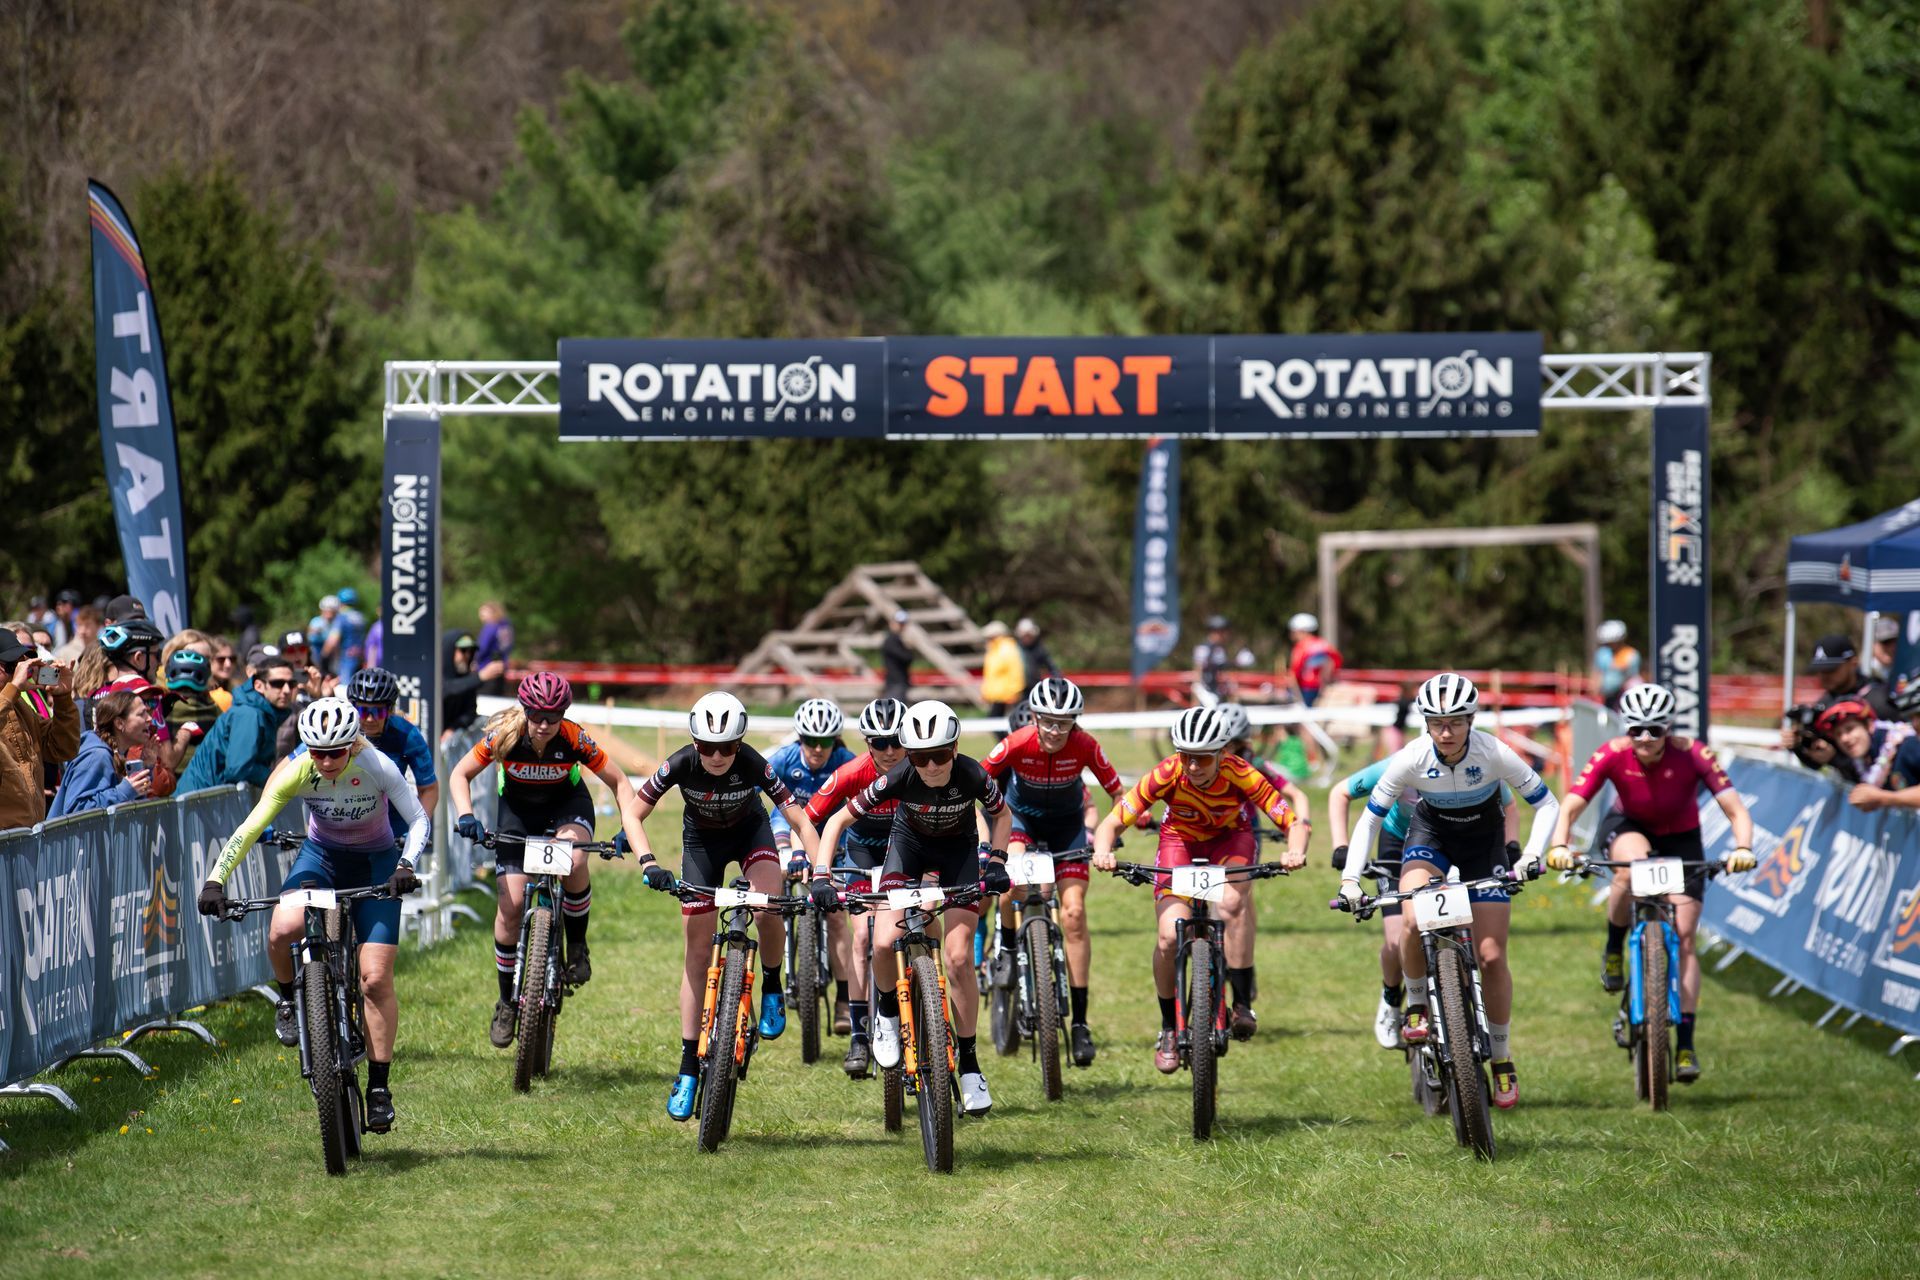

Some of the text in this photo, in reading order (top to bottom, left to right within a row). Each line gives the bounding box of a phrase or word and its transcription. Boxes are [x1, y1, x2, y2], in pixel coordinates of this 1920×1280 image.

[588, 356, 856, 421] ROTATION
[925, 355, 1172, 417] START
[1240, 350, 1513, 418] ROTATION
[641, 406, 856, 422] ENGINEERING
[1294, 401, 1513, 418] ENGINEERING
[389, 475, 427, 635] ROTATION
[1660, 624, 1699, 738] ROTATI
[332, 800, 377, 820] Shefford
[543, 846, 553, 864] 8
[1191, 872, 1209, 889] 13
[1649, 866, 1668, 884] 10
[1435, 894, 1448, 916] 2
[901, 1022, 911, 1049] FOX
